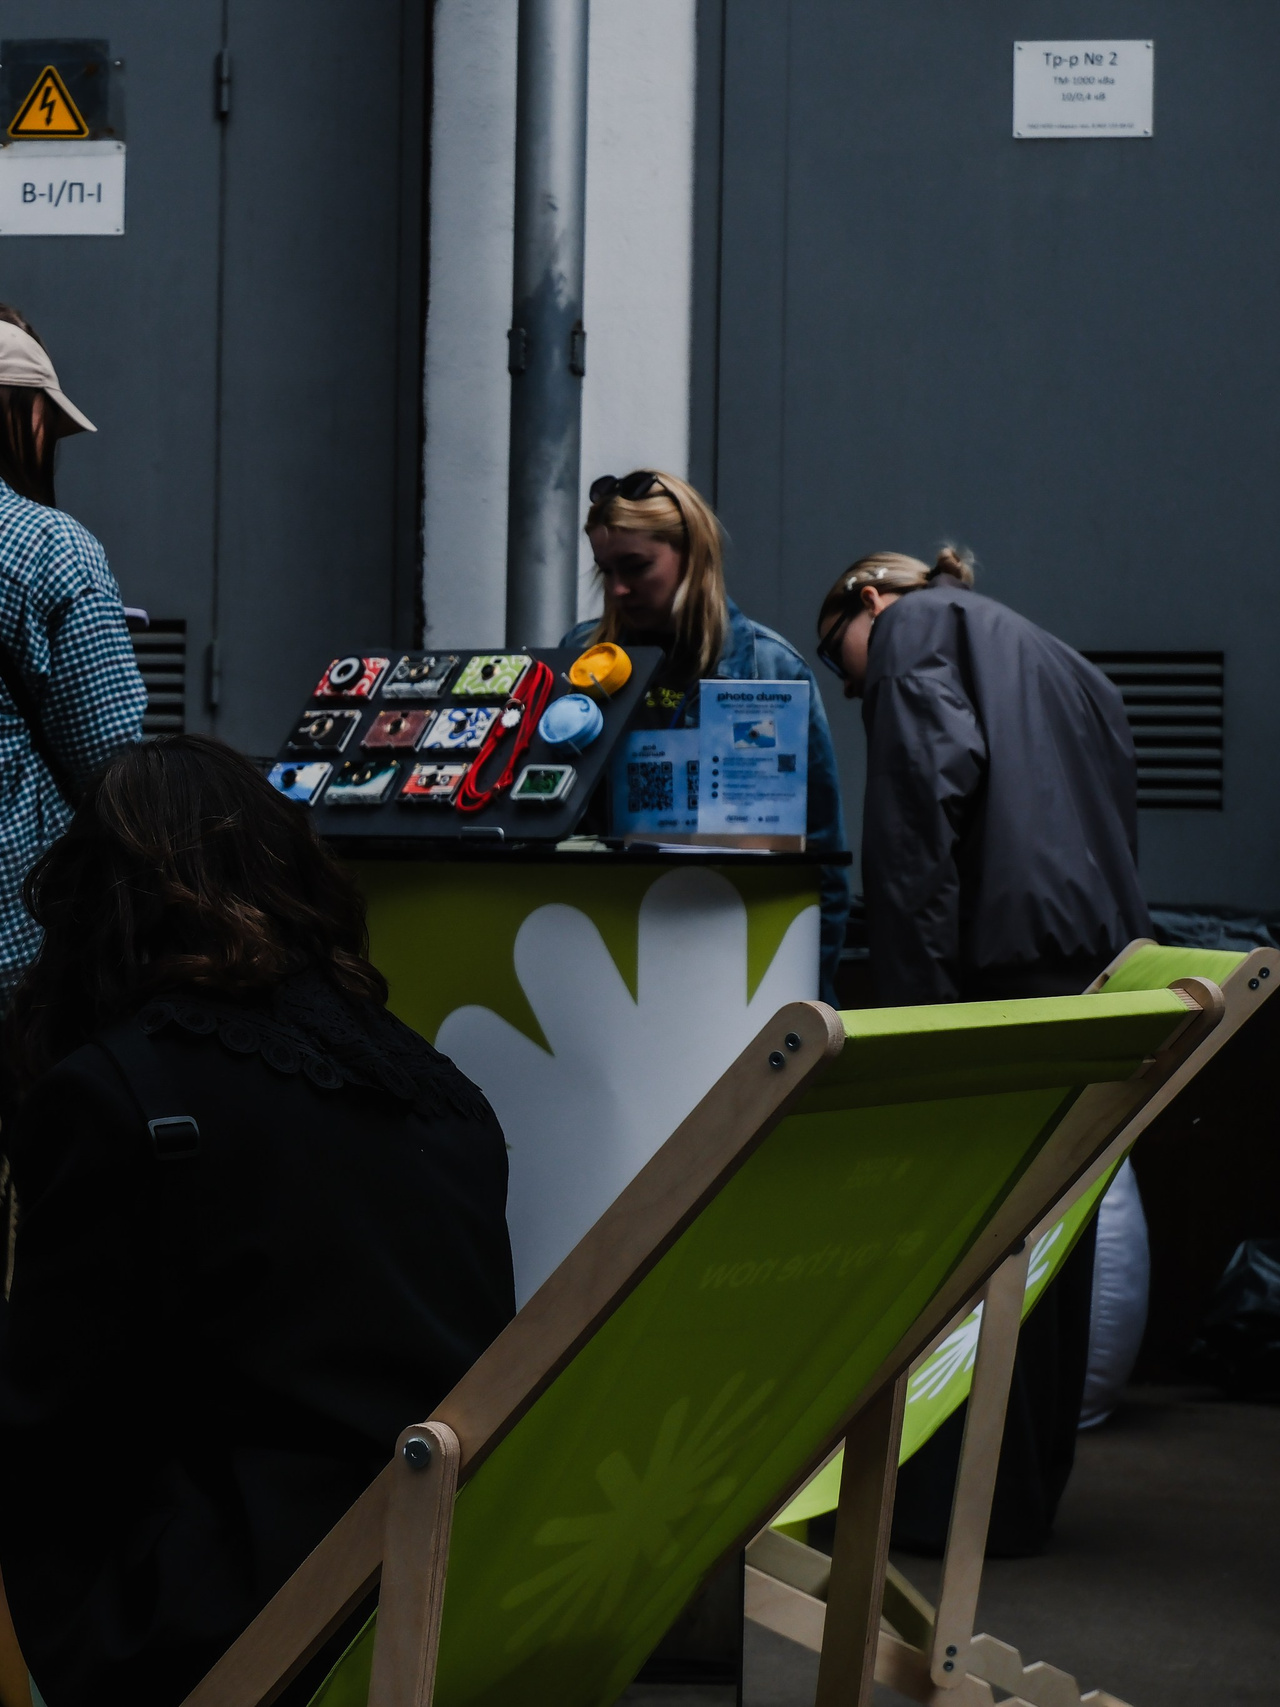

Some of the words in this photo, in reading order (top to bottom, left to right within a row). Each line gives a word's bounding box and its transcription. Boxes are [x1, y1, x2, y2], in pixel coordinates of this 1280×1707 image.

[1043, 52, 1079, 69] Тр-р
[1084, 52, 1103, 66] №
[1109, 51, 1118, 66] 2
[717, 692, 754, 702] photo
[756, 691, 792, 703] dump
